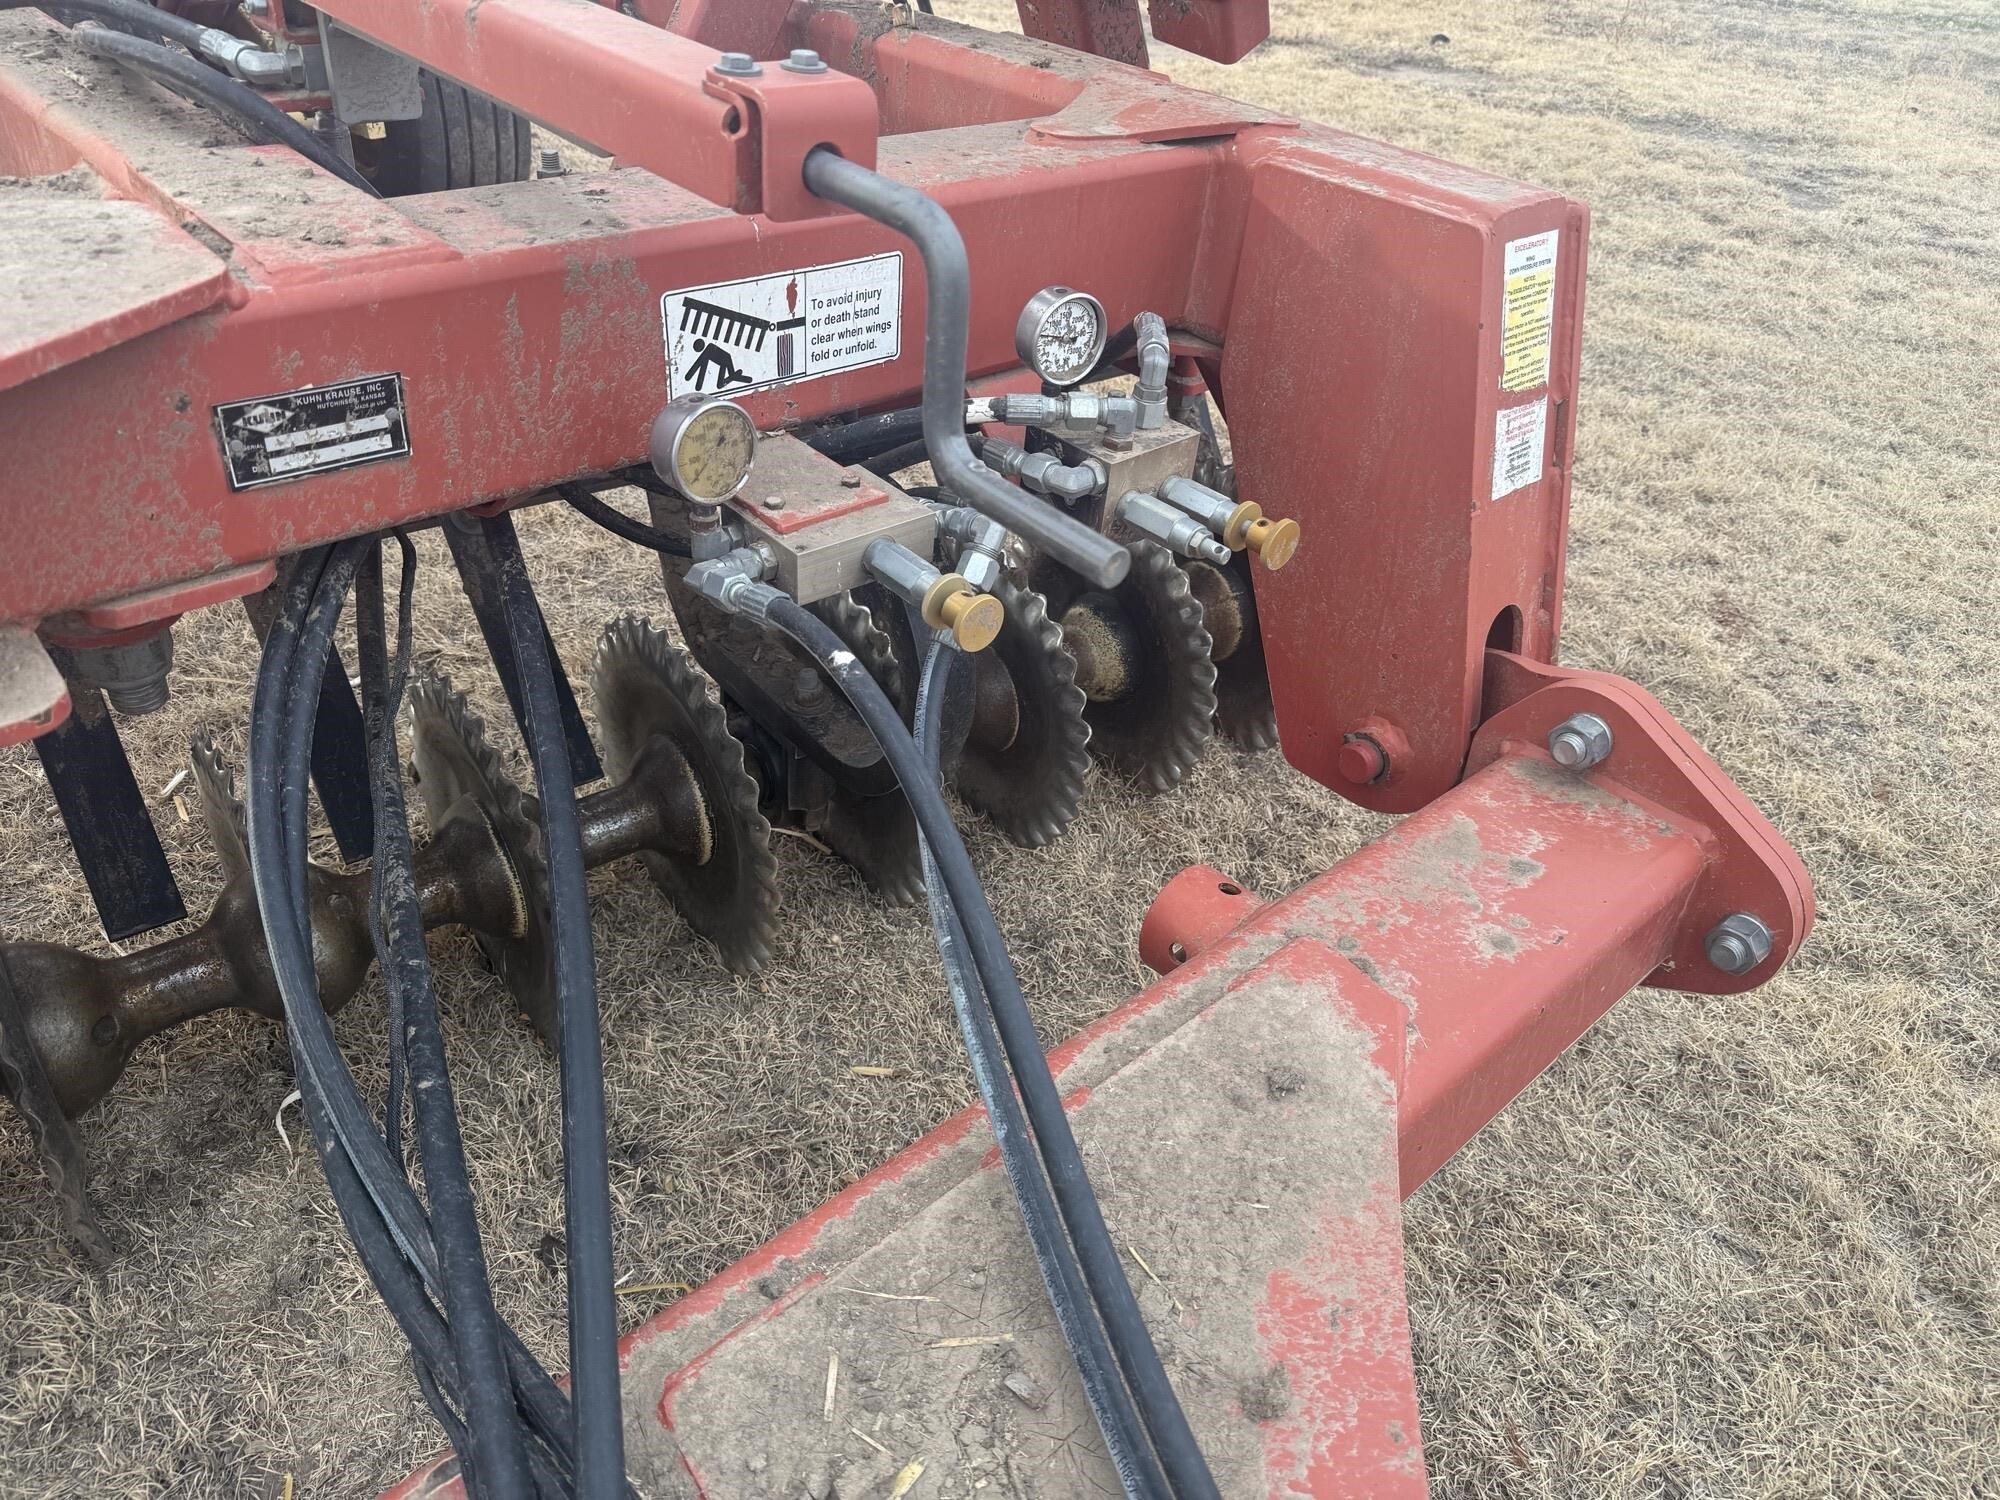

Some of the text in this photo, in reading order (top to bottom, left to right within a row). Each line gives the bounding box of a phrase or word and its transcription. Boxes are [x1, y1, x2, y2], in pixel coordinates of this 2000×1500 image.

[811, 288, 882, 310] To avoid injury
[811, 304, 880, 328] or death stand
[811, 321, 892, 346] clear when wings
[811, 347, 831, 362] fold
[832, 346, 844, 358] or
[845, 339, 878, 355] unfold.
[296, 394, 323, 407] KUHN
[366, 382, 385, 394] INC.
[361, 391, 386, 403] KANSAS
[376, 399, 387, 407] USA
